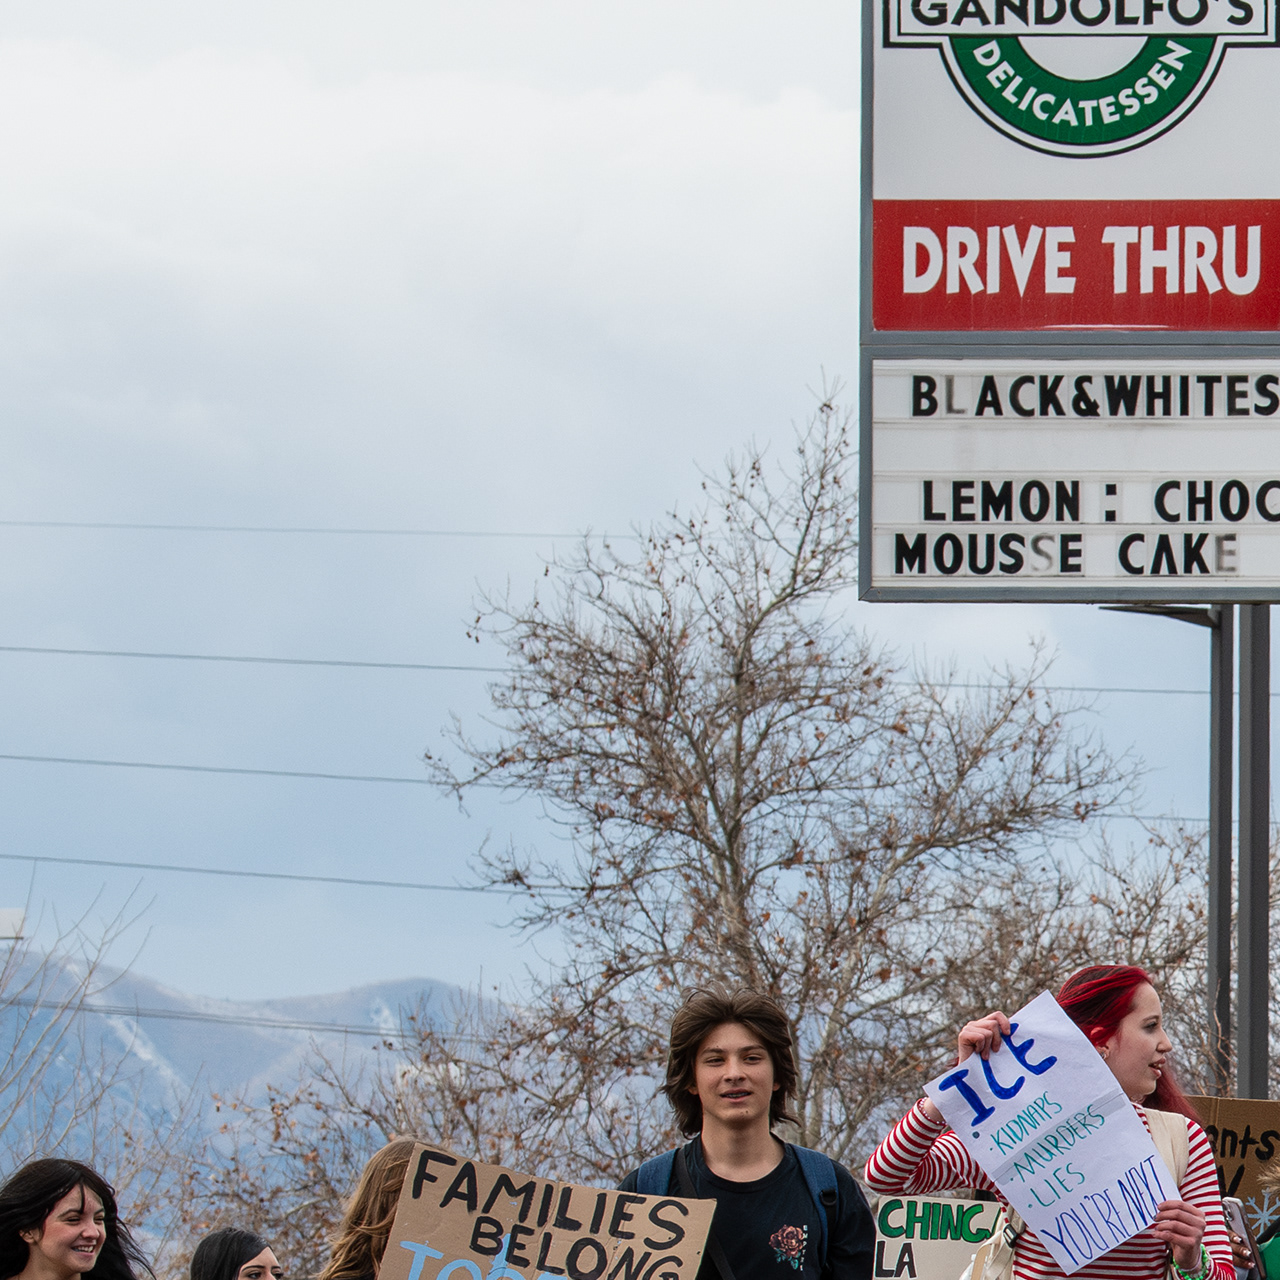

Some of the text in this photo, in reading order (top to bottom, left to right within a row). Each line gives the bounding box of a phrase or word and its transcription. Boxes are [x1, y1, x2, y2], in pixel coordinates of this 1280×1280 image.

[911, 0, 1254, 26] GANDOLFO'S
[972, 39, 1193, 127] DELICATESSEN
[903, 224, 1262, 298] DRIVE THRU
[911, 374, 1280, 417] BLACK&WHITES
[922, 480, 1080, 522] LEMON
[894, 532, 1237, 575] MOUSSE CAKE
[938, 1022, 1058, 1127] ICE
[991, 1090, 1064, 1157] KIDNAPS
[1013, 1104, 1106, 1185] MURDERS
[411, 1149, 689, 1251] FAMILIES
[1029, 1162, 1086, 1208] LIES
[1041, 1187, 1124, 1266] YOU'RE
[1116, 1154, 1168, 1227] NEXT
[878, 1198, 1001, 1243] CHING
[874, 1240, 917, 1279] LA
